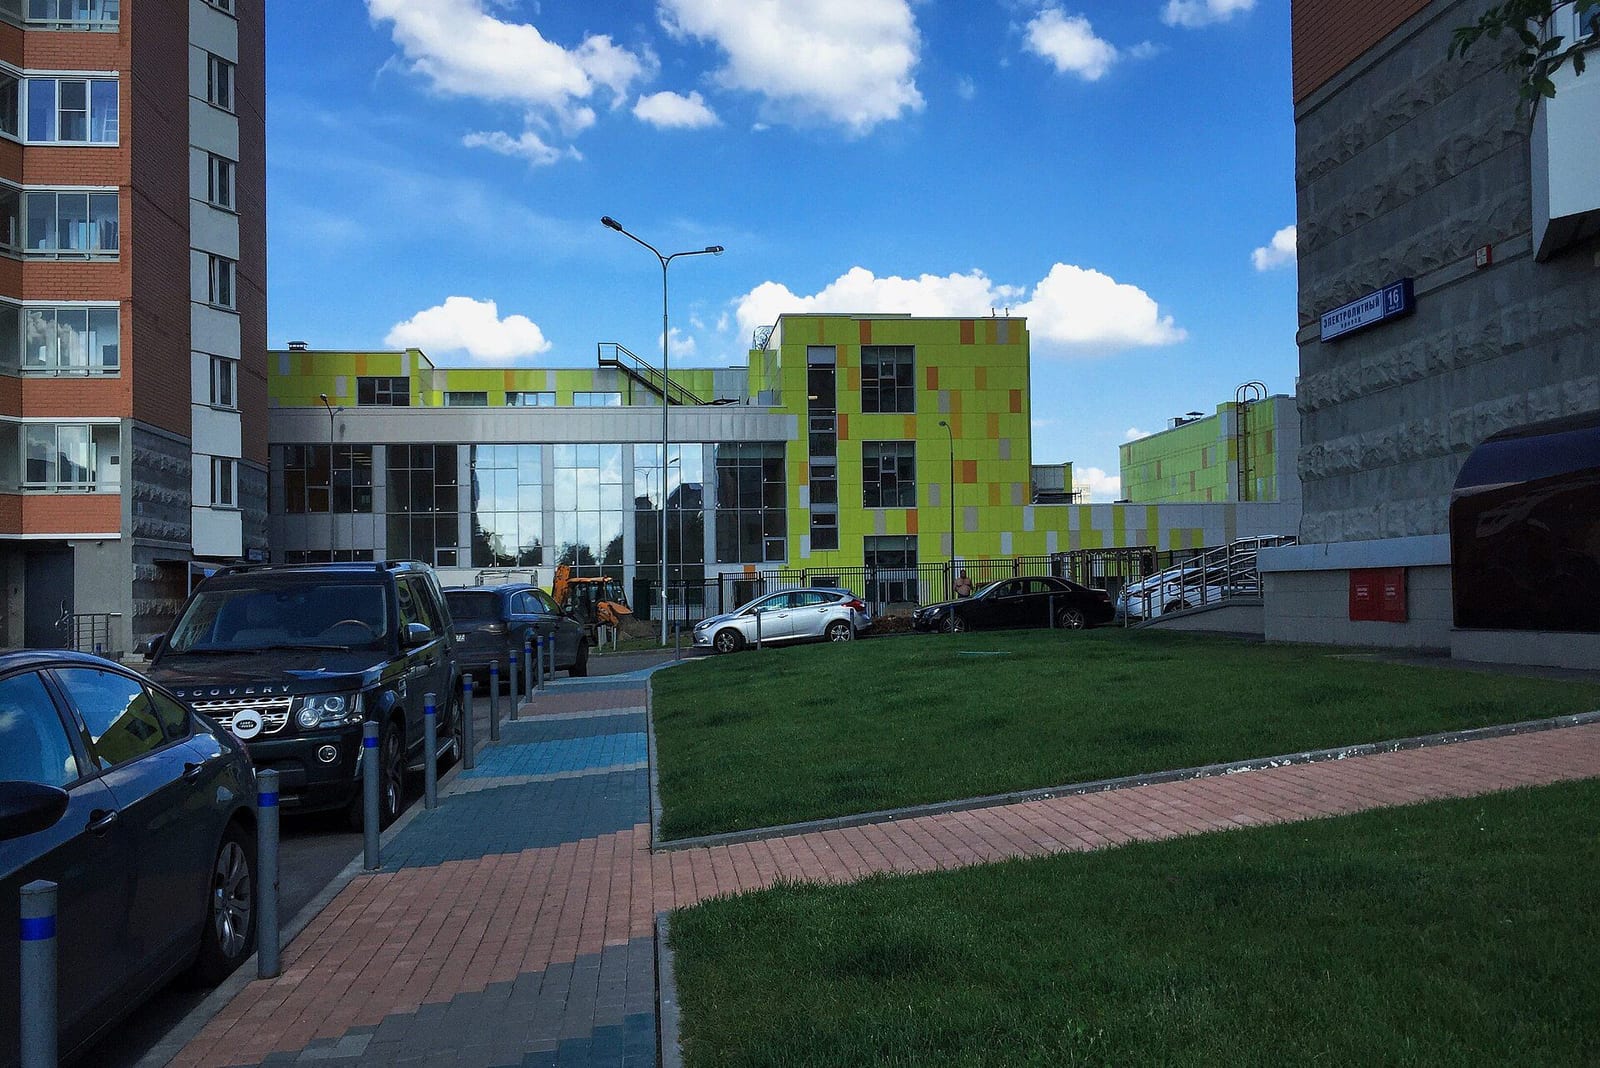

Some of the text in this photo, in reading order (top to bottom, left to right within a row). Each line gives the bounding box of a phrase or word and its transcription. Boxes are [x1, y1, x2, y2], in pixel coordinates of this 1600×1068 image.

[1387, 289, 1399, 306] 16
[1323, 295, 1380, 329] ЭЛЕКТРОЛИТНЫЙ
[176, 685, 290, 697] SCOVERY
